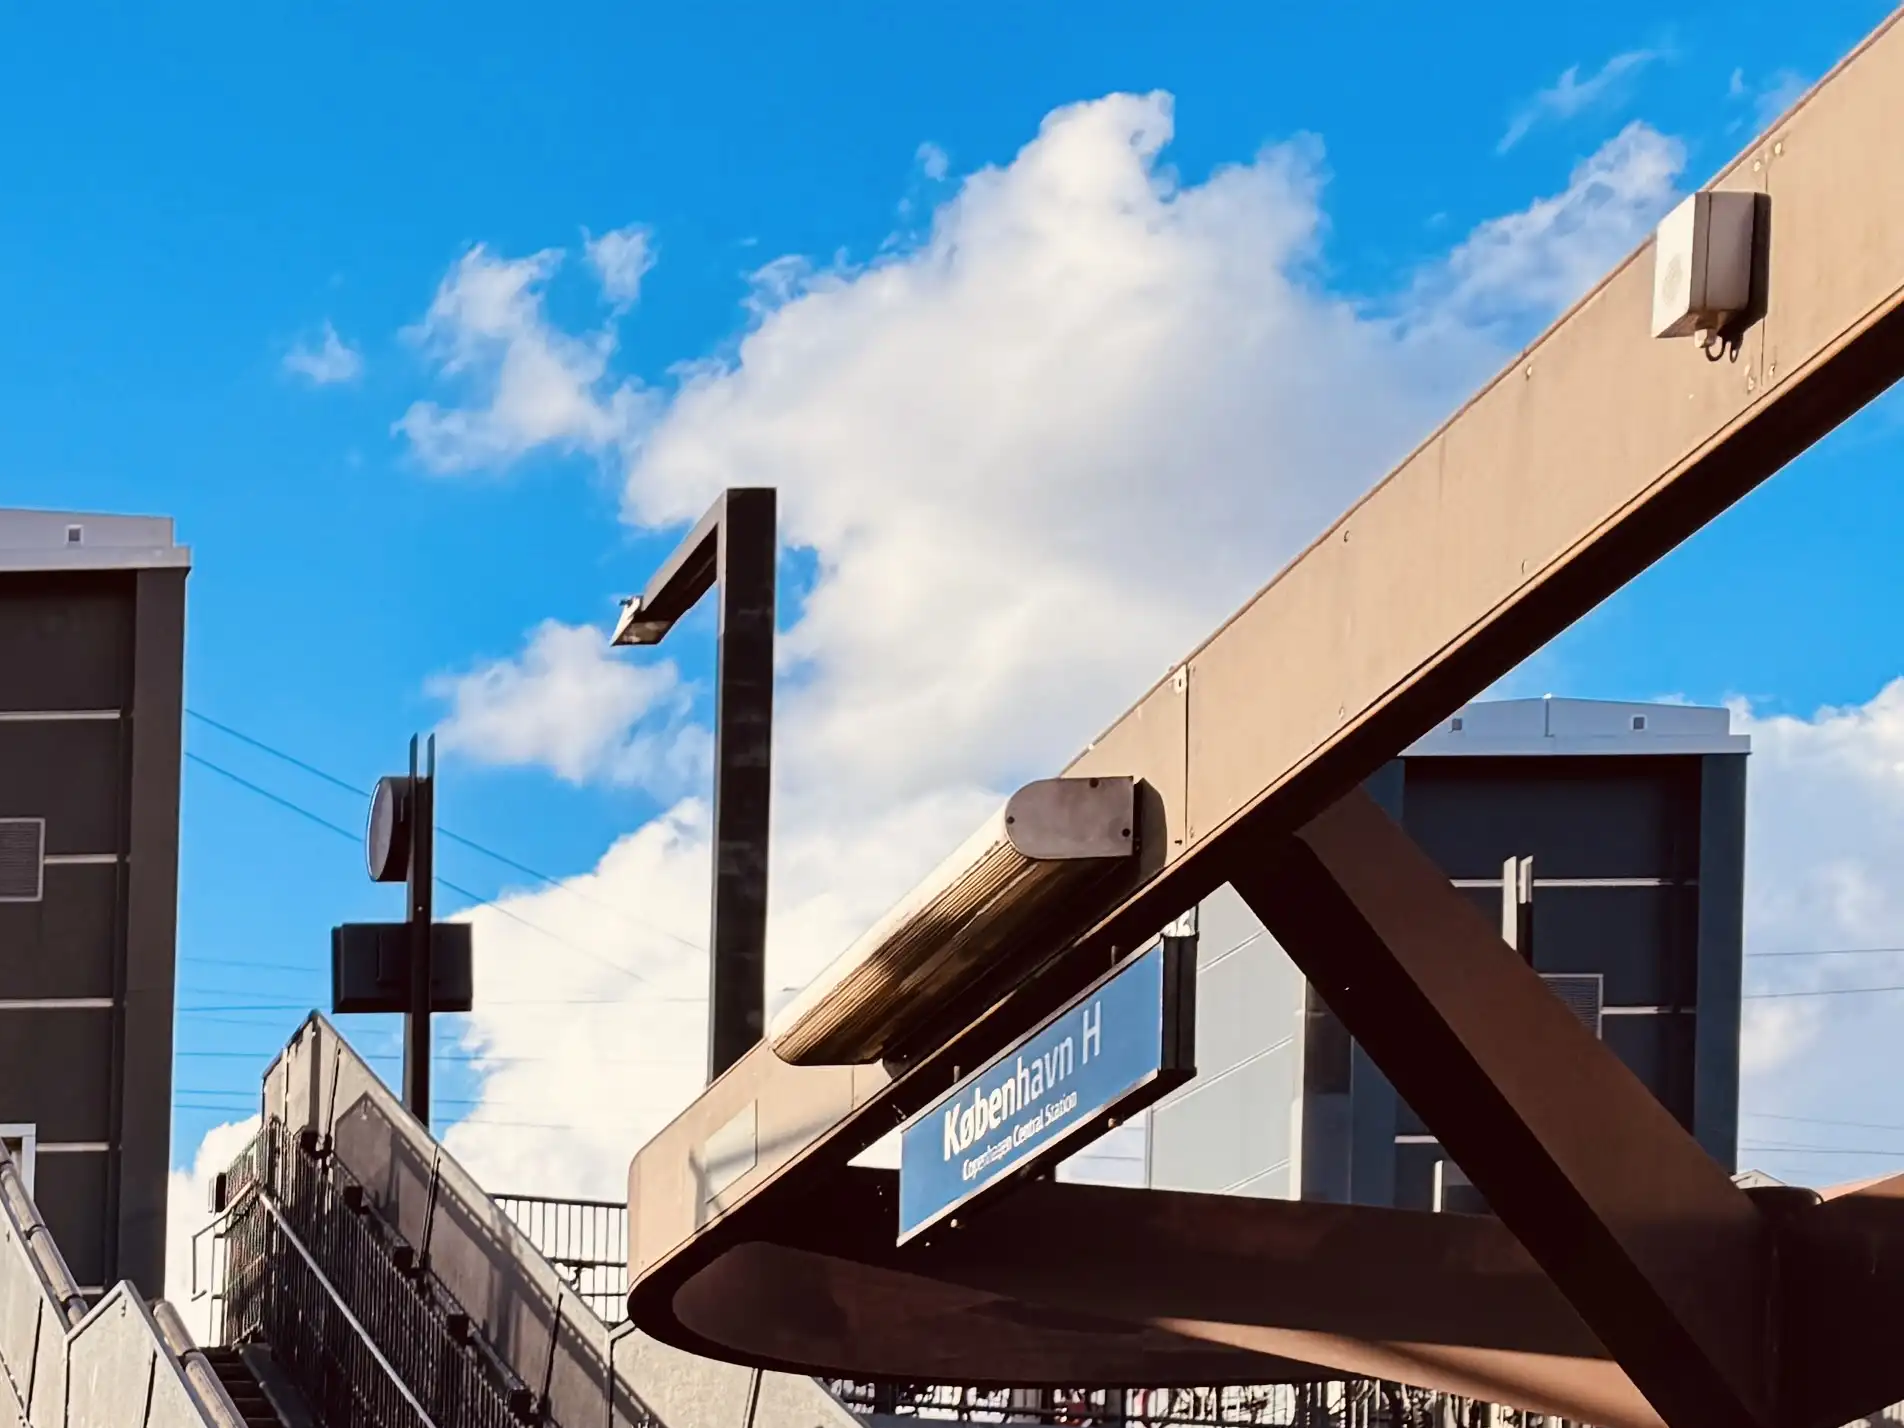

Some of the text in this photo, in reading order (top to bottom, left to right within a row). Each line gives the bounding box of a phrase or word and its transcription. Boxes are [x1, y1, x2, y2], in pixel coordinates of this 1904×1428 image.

[944, 1001, 1101, 1161] København H
[962, 1090, 1078, 1181] Copenhagen Central Station
